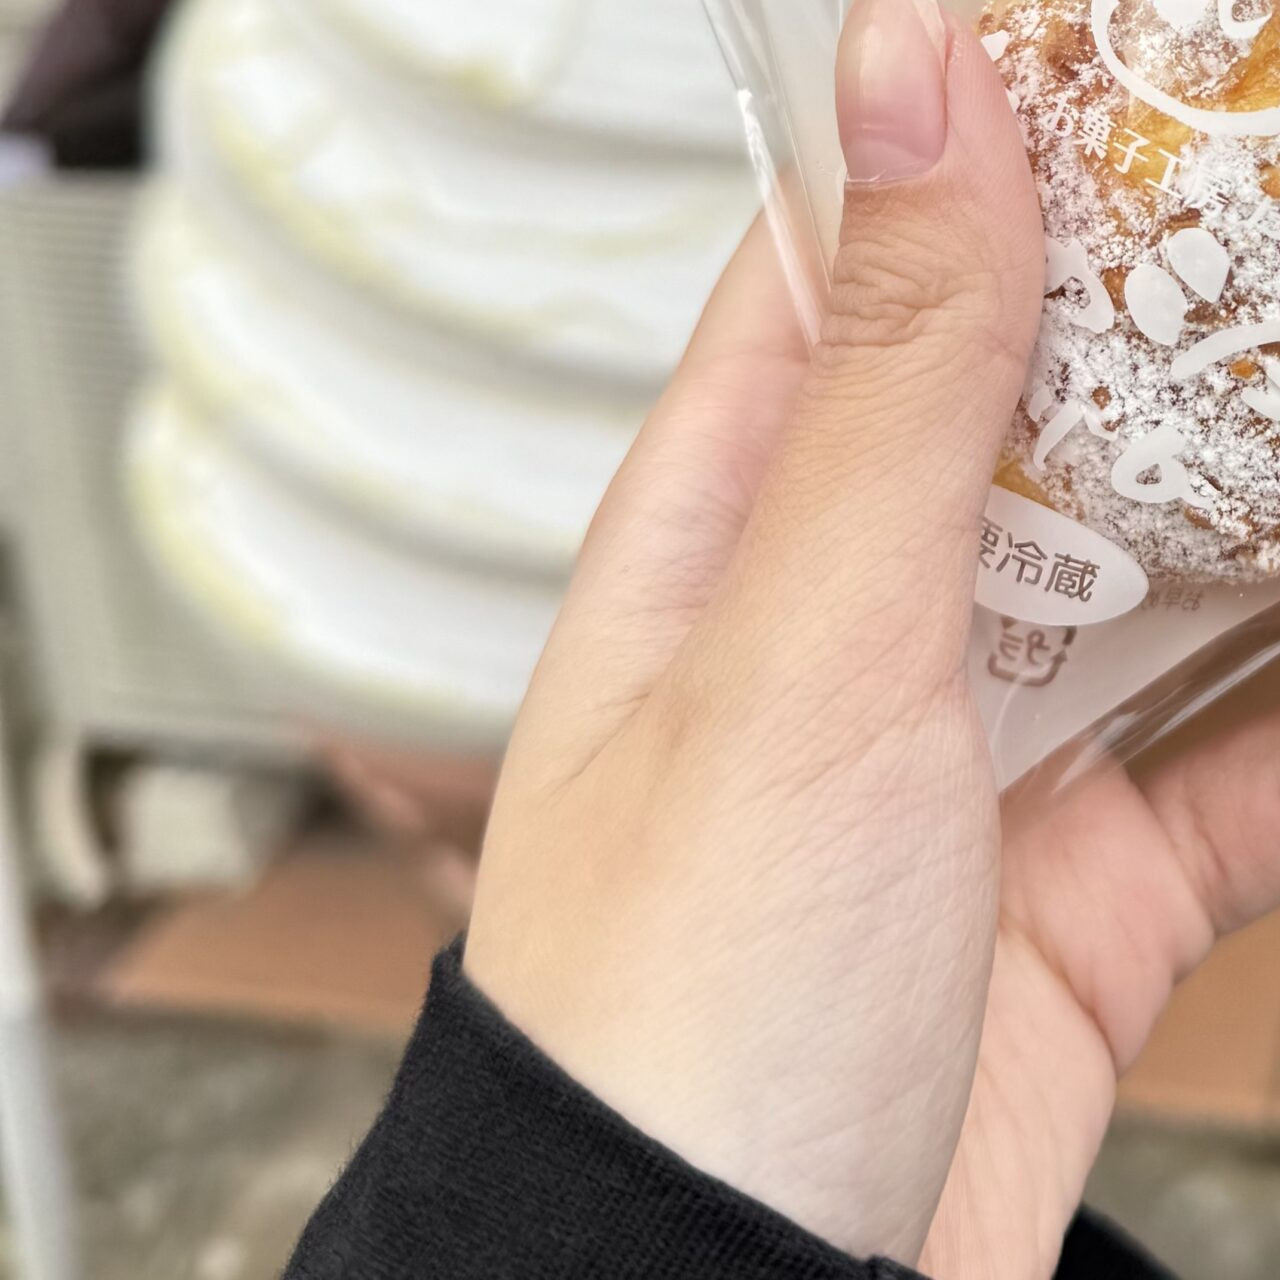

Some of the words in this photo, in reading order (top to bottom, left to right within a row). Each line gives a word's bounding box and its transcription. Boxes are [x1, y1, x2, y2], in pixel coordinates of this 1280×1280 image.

[1038, 95, 1231, 217] お菓子工房
